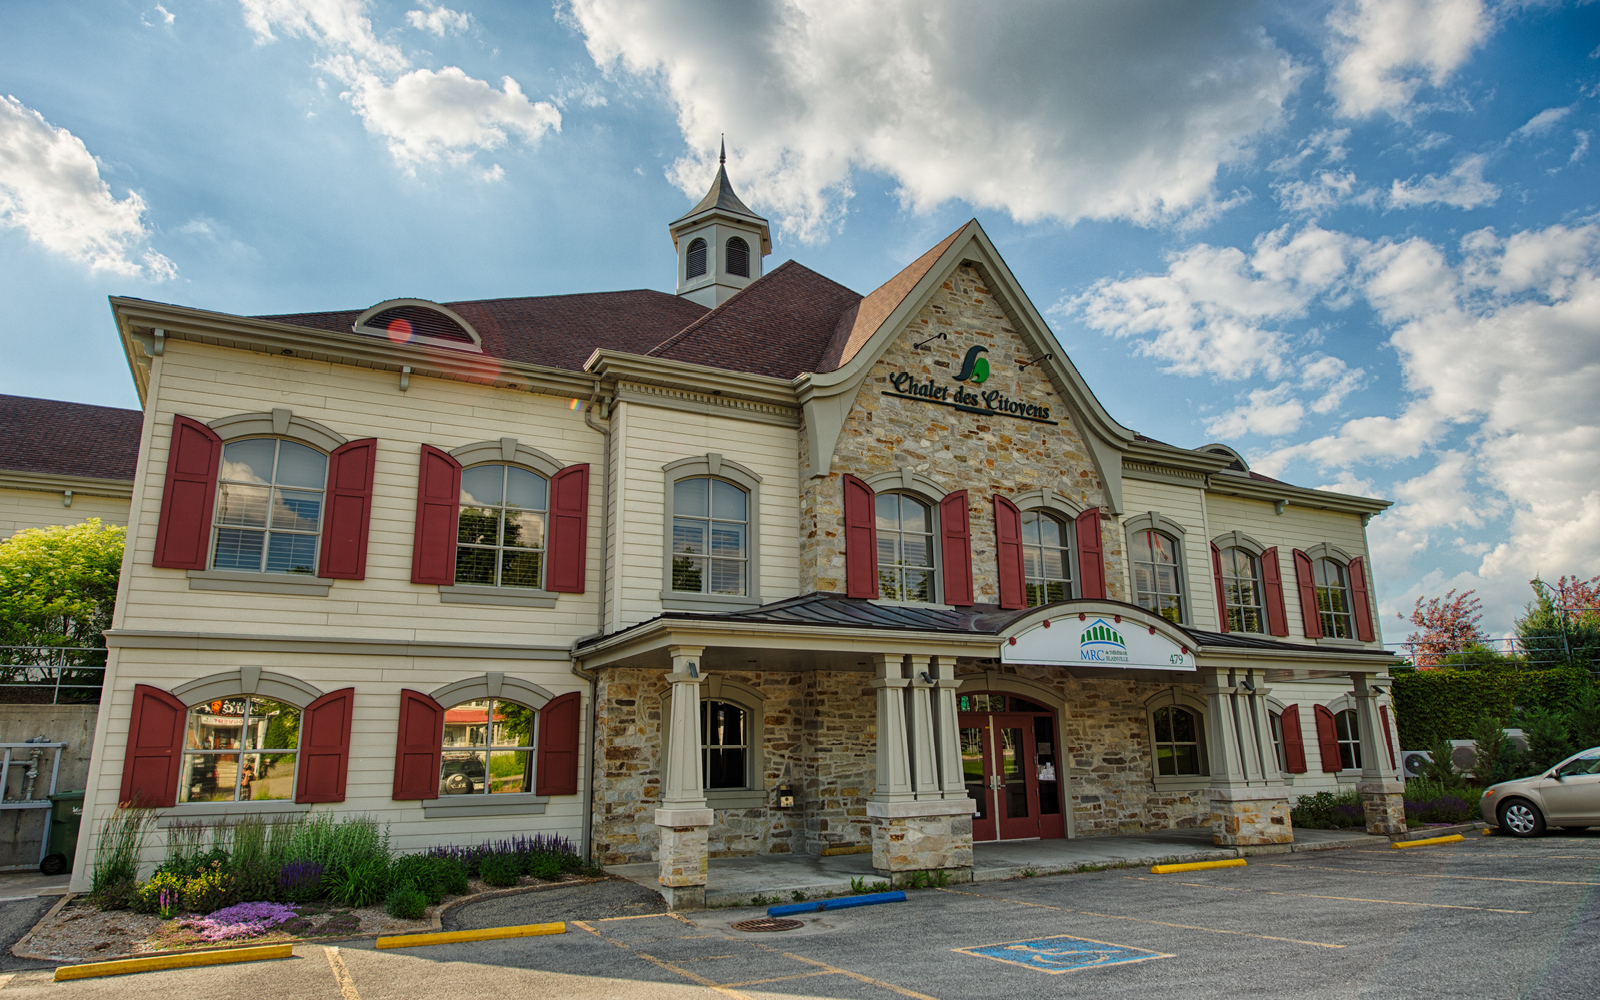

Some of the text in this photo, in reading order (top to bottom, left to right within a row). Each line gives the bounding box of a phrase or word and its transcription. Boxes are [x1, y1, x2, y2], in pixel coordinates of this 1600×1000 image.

[890, 372, 1050, 419] Chalet des Citoyens
[1080, 650, 1105, 661] MRC
[1170, 654, 1184, 664] 479
